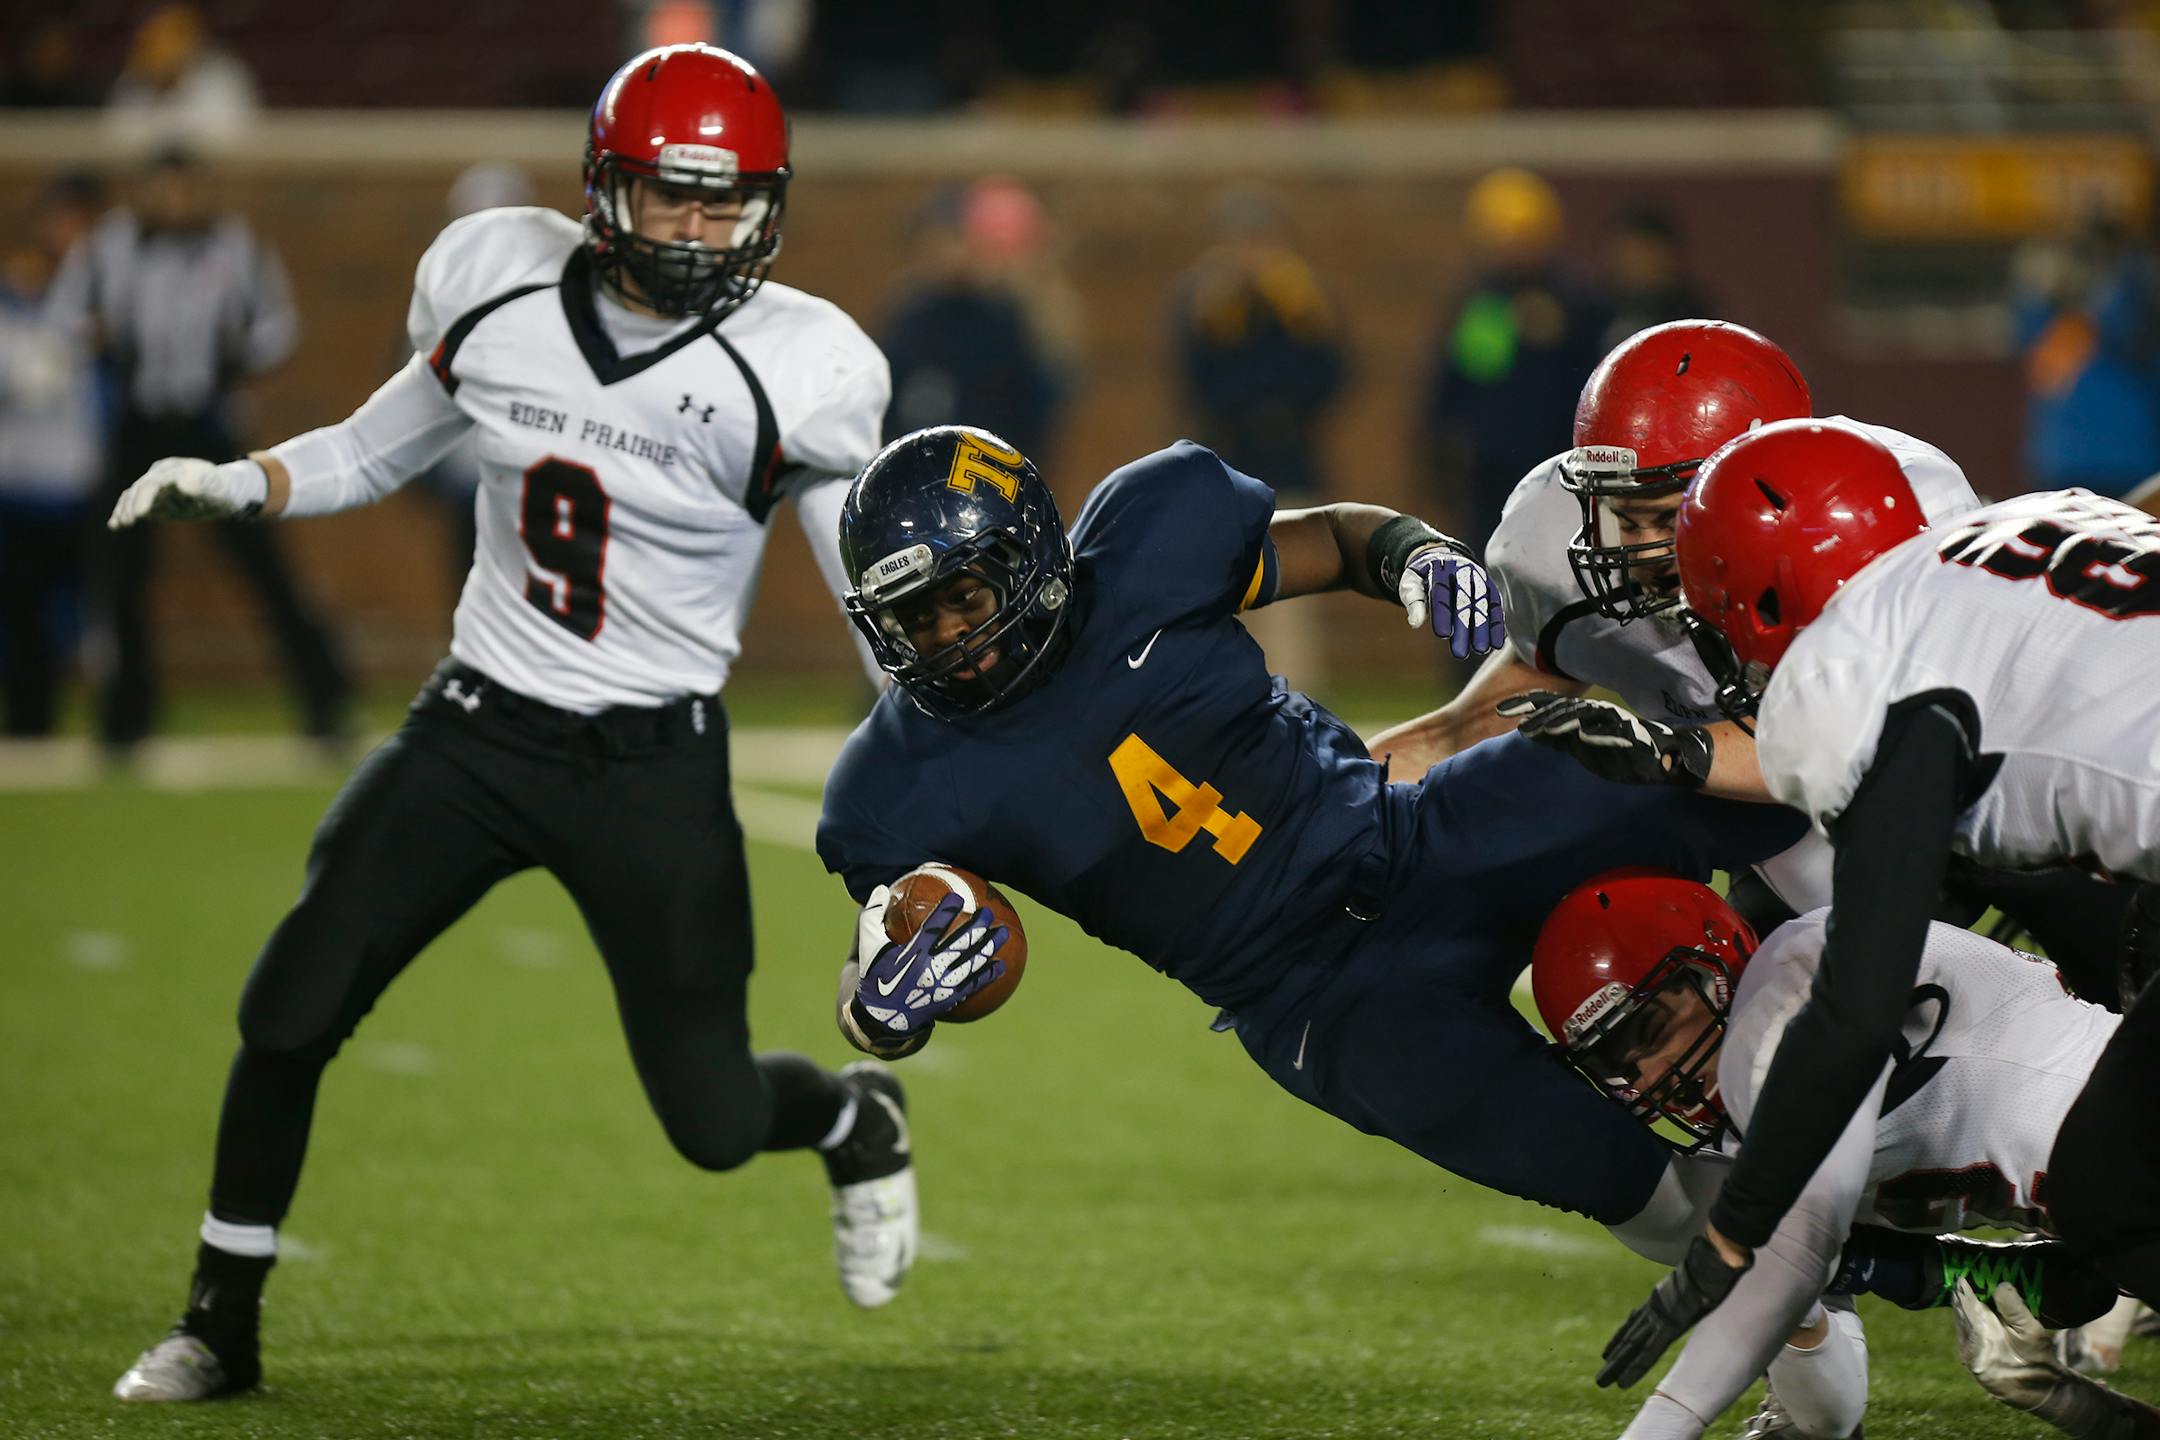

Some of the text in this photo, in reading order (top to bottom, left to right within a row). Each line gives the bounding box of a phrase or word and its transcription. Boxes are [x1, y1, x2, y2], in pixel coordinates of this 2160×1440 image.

[508, 401, 679, 465] EDEN PRAIRIE
[1586, 450, 1619, 463] Riddell
[520, 453, 612, 642] 9
[879, 555, 911, 576] EAGLES
[1108, 732, 1264, 867] 4
[1575, 991, 1610, 1025] Riddell
